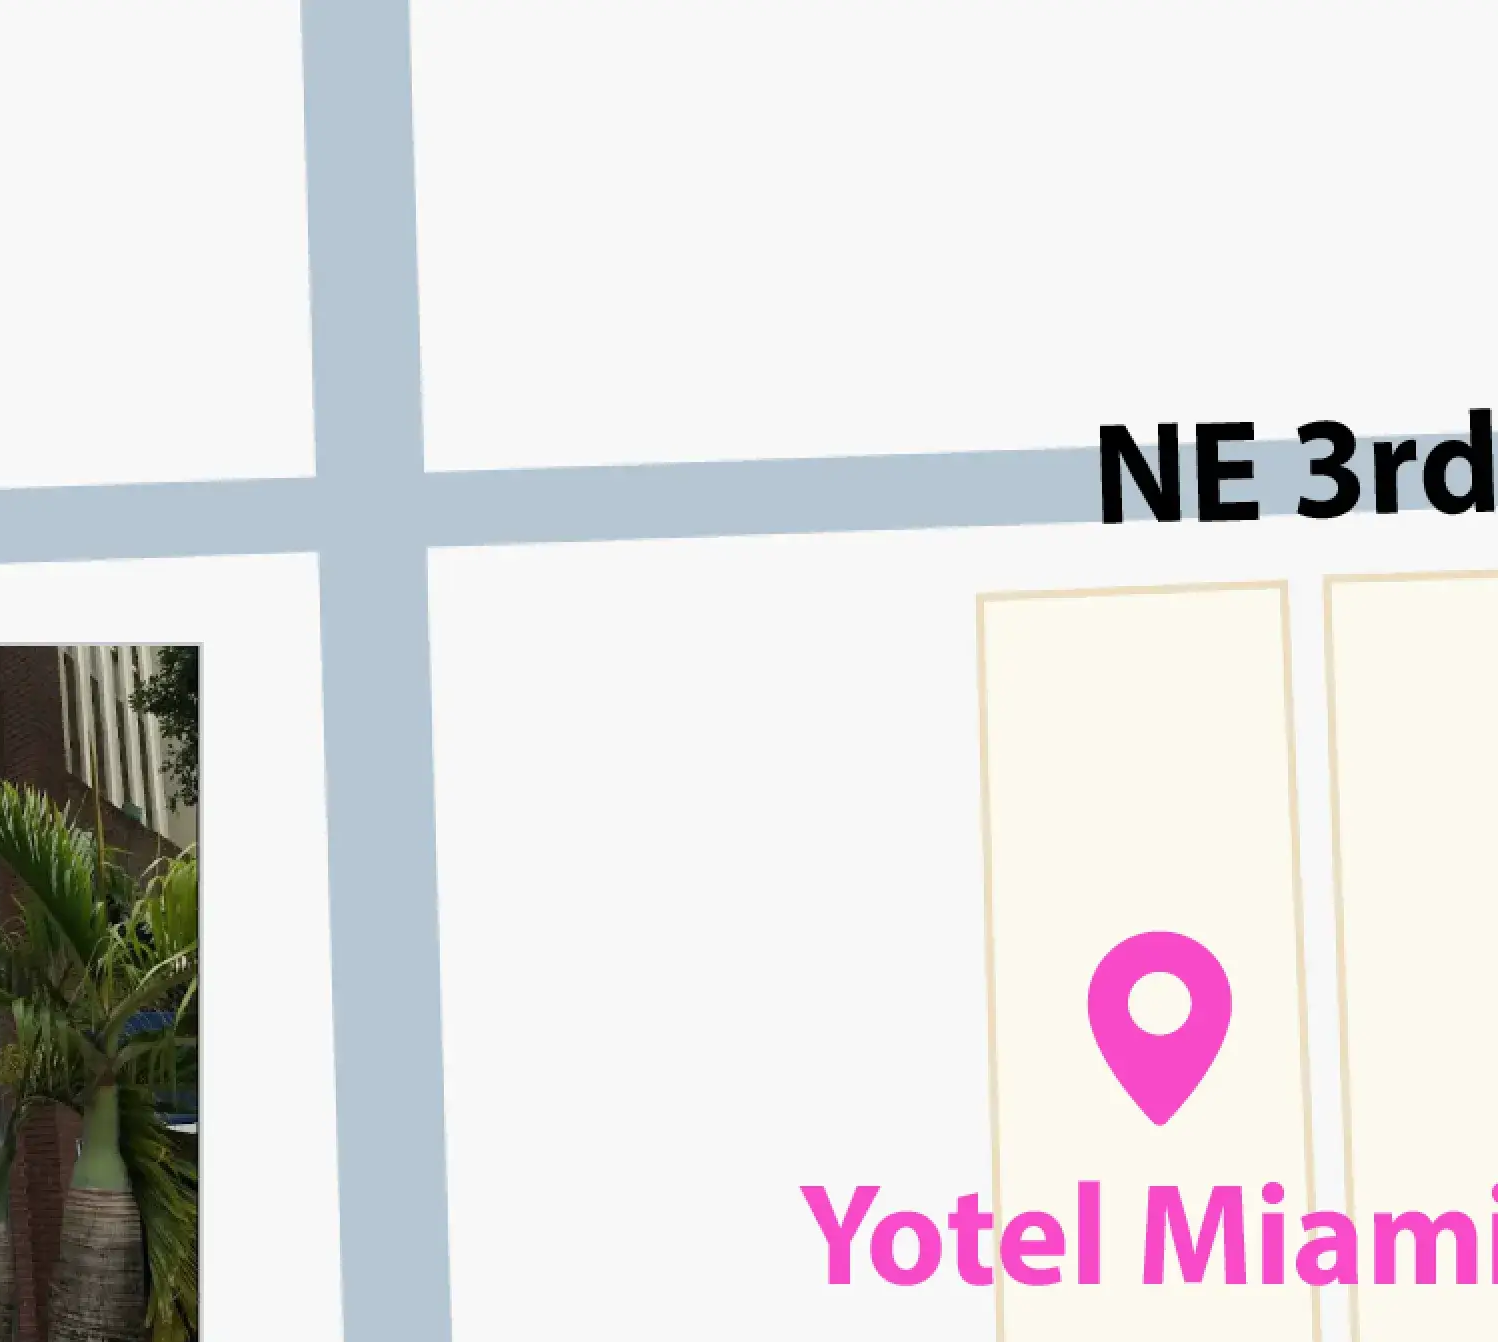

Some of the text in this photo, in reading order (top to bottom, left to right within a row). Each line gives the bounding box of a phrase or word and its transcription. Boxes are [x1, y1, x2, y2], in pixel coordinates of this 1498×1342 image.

[1098, 420, 1260, 526] NE
[1296, 406, 1496, 520] 3rd
[799, 1180, 1102, 1288] Yotel
